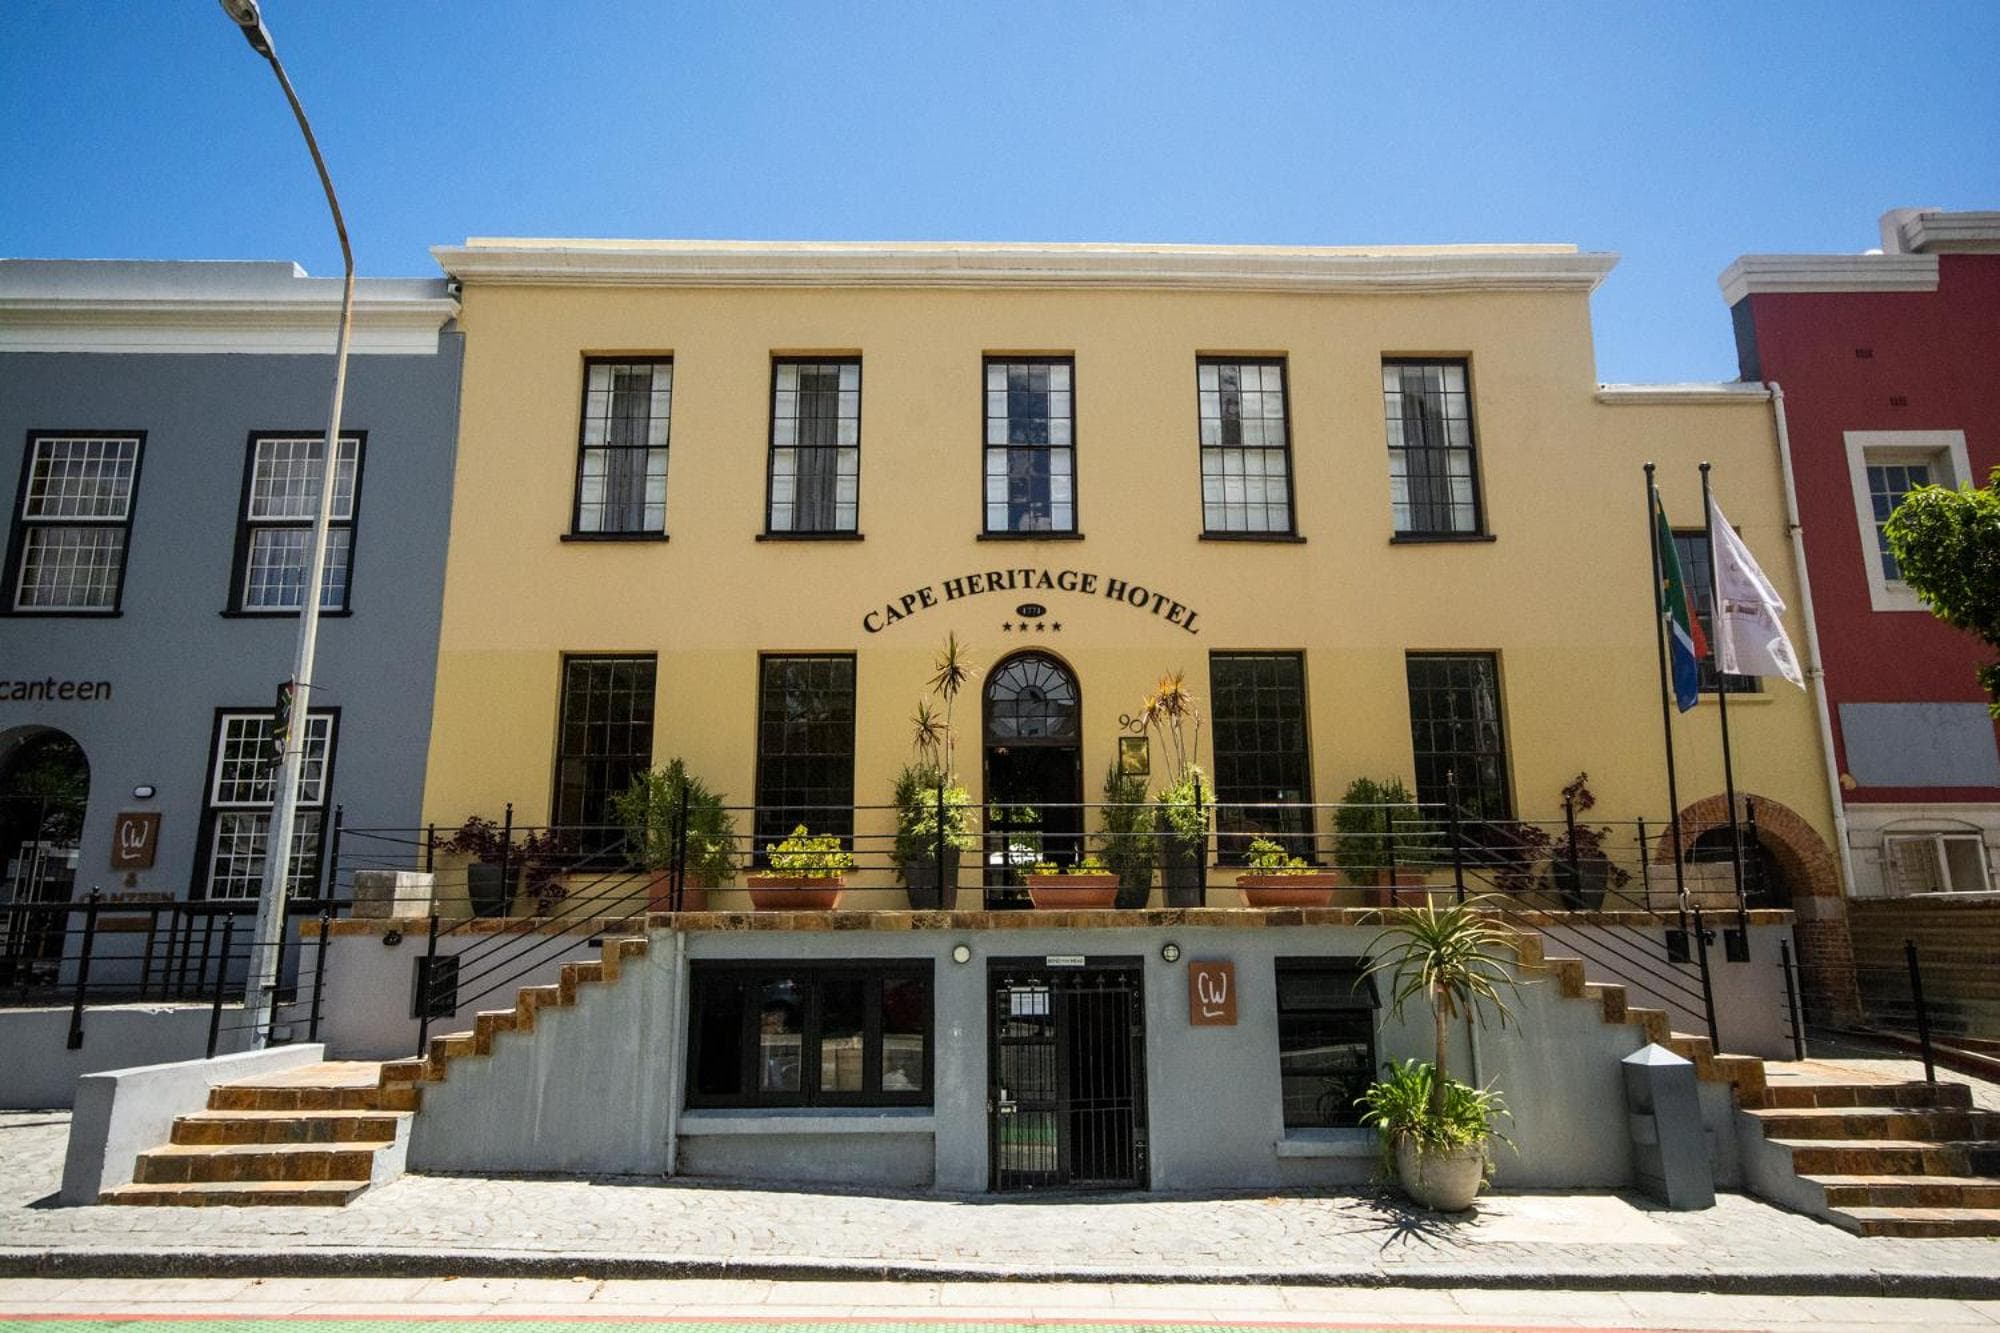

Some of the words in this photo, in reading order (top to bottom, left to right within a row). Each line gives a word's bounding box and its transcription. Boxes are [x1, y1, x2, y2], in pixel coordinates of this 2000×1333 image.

[863, 585, 938, 634] CAPE
[942, 568, 1098, 601] HERITAGE
[1105, 578, 1200, 635] HOTEL
[0, 676, 112, 701] canteen
[1118, 714, 1144, 734] 90
